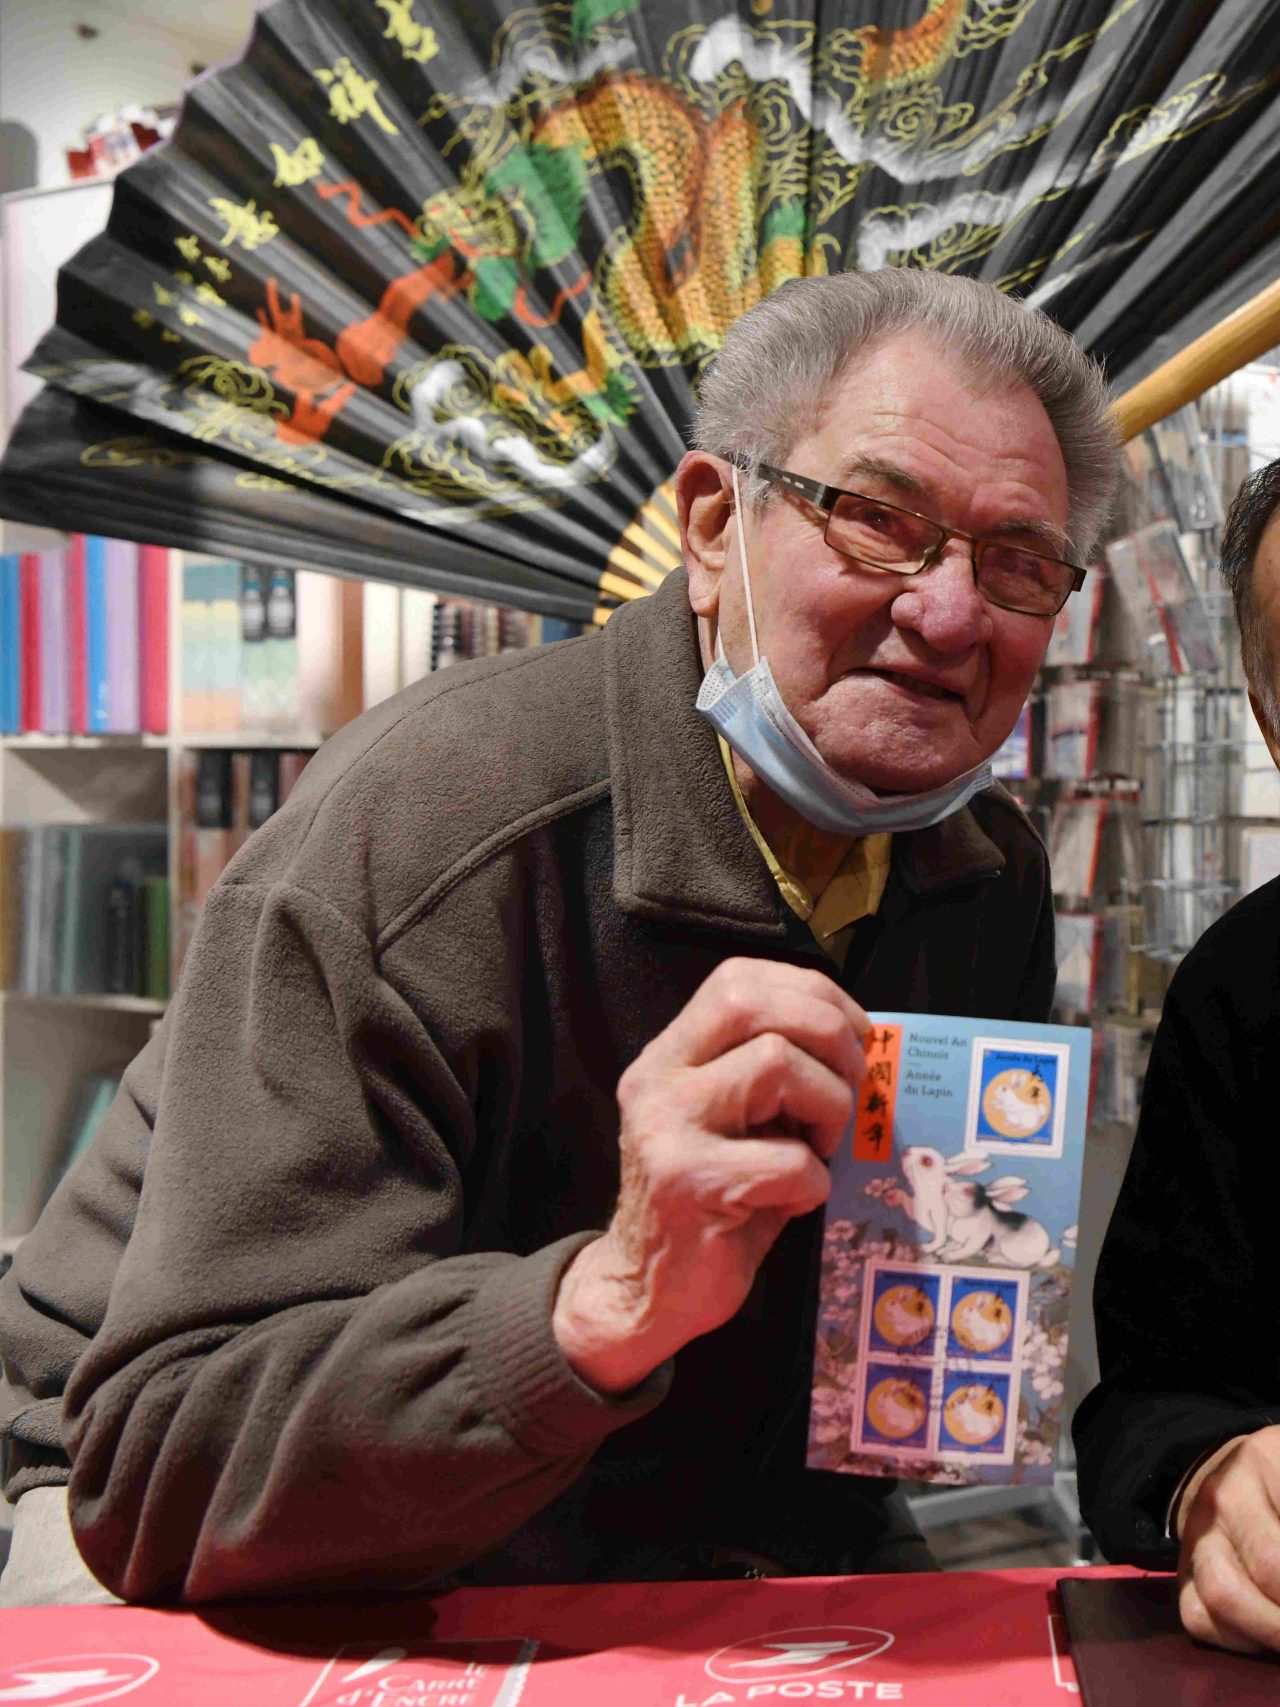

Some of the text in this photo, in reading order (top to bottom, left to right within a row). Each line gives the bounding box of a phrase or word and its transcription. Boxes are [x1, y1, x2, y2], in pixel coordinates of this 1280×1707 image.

[909, 1032, 967, 1047] Nouvel An
[907, 1046, 949, 1060] Chinois
[905, 1069, 942, 1081] Année
[904, 1084, 953, 1098] du Lapin
[675, 1680, 904, 1707] LA POSTE
